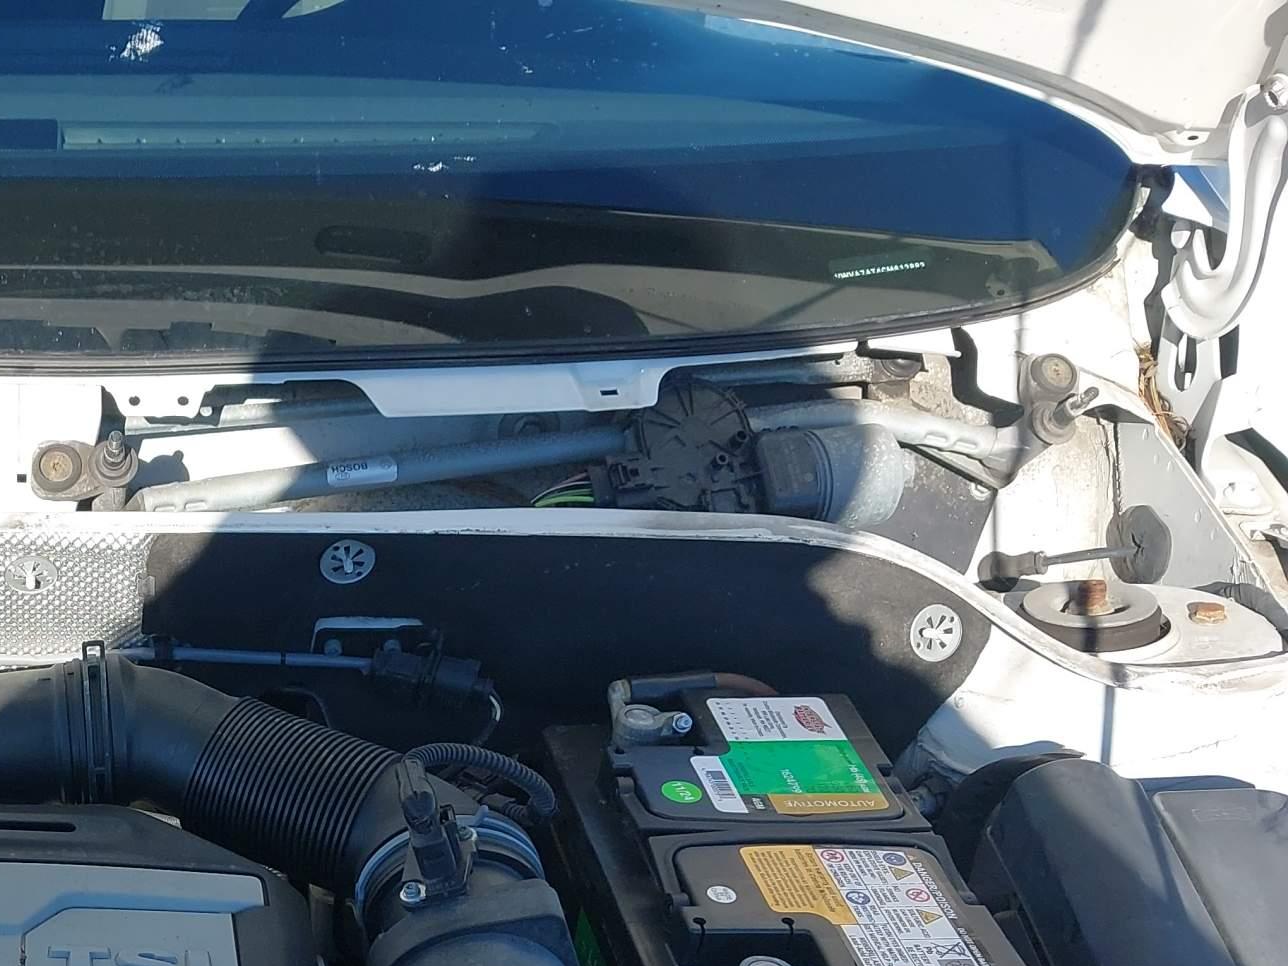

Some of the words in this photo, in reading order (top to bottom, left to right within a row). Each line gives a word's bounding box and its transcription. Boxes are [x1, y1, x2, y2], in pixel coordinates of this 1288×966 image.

[332, 463, 368, 473] BOSCH
[672, 783, 694, 800] 11/24
[784, 800, 875, 808] AUTOMOTIVE
[911, 862, 958, 918] DANGER/POISON
[913, 944, 931, 964] BATTERY
[923, 946, 934, 954] Pb
